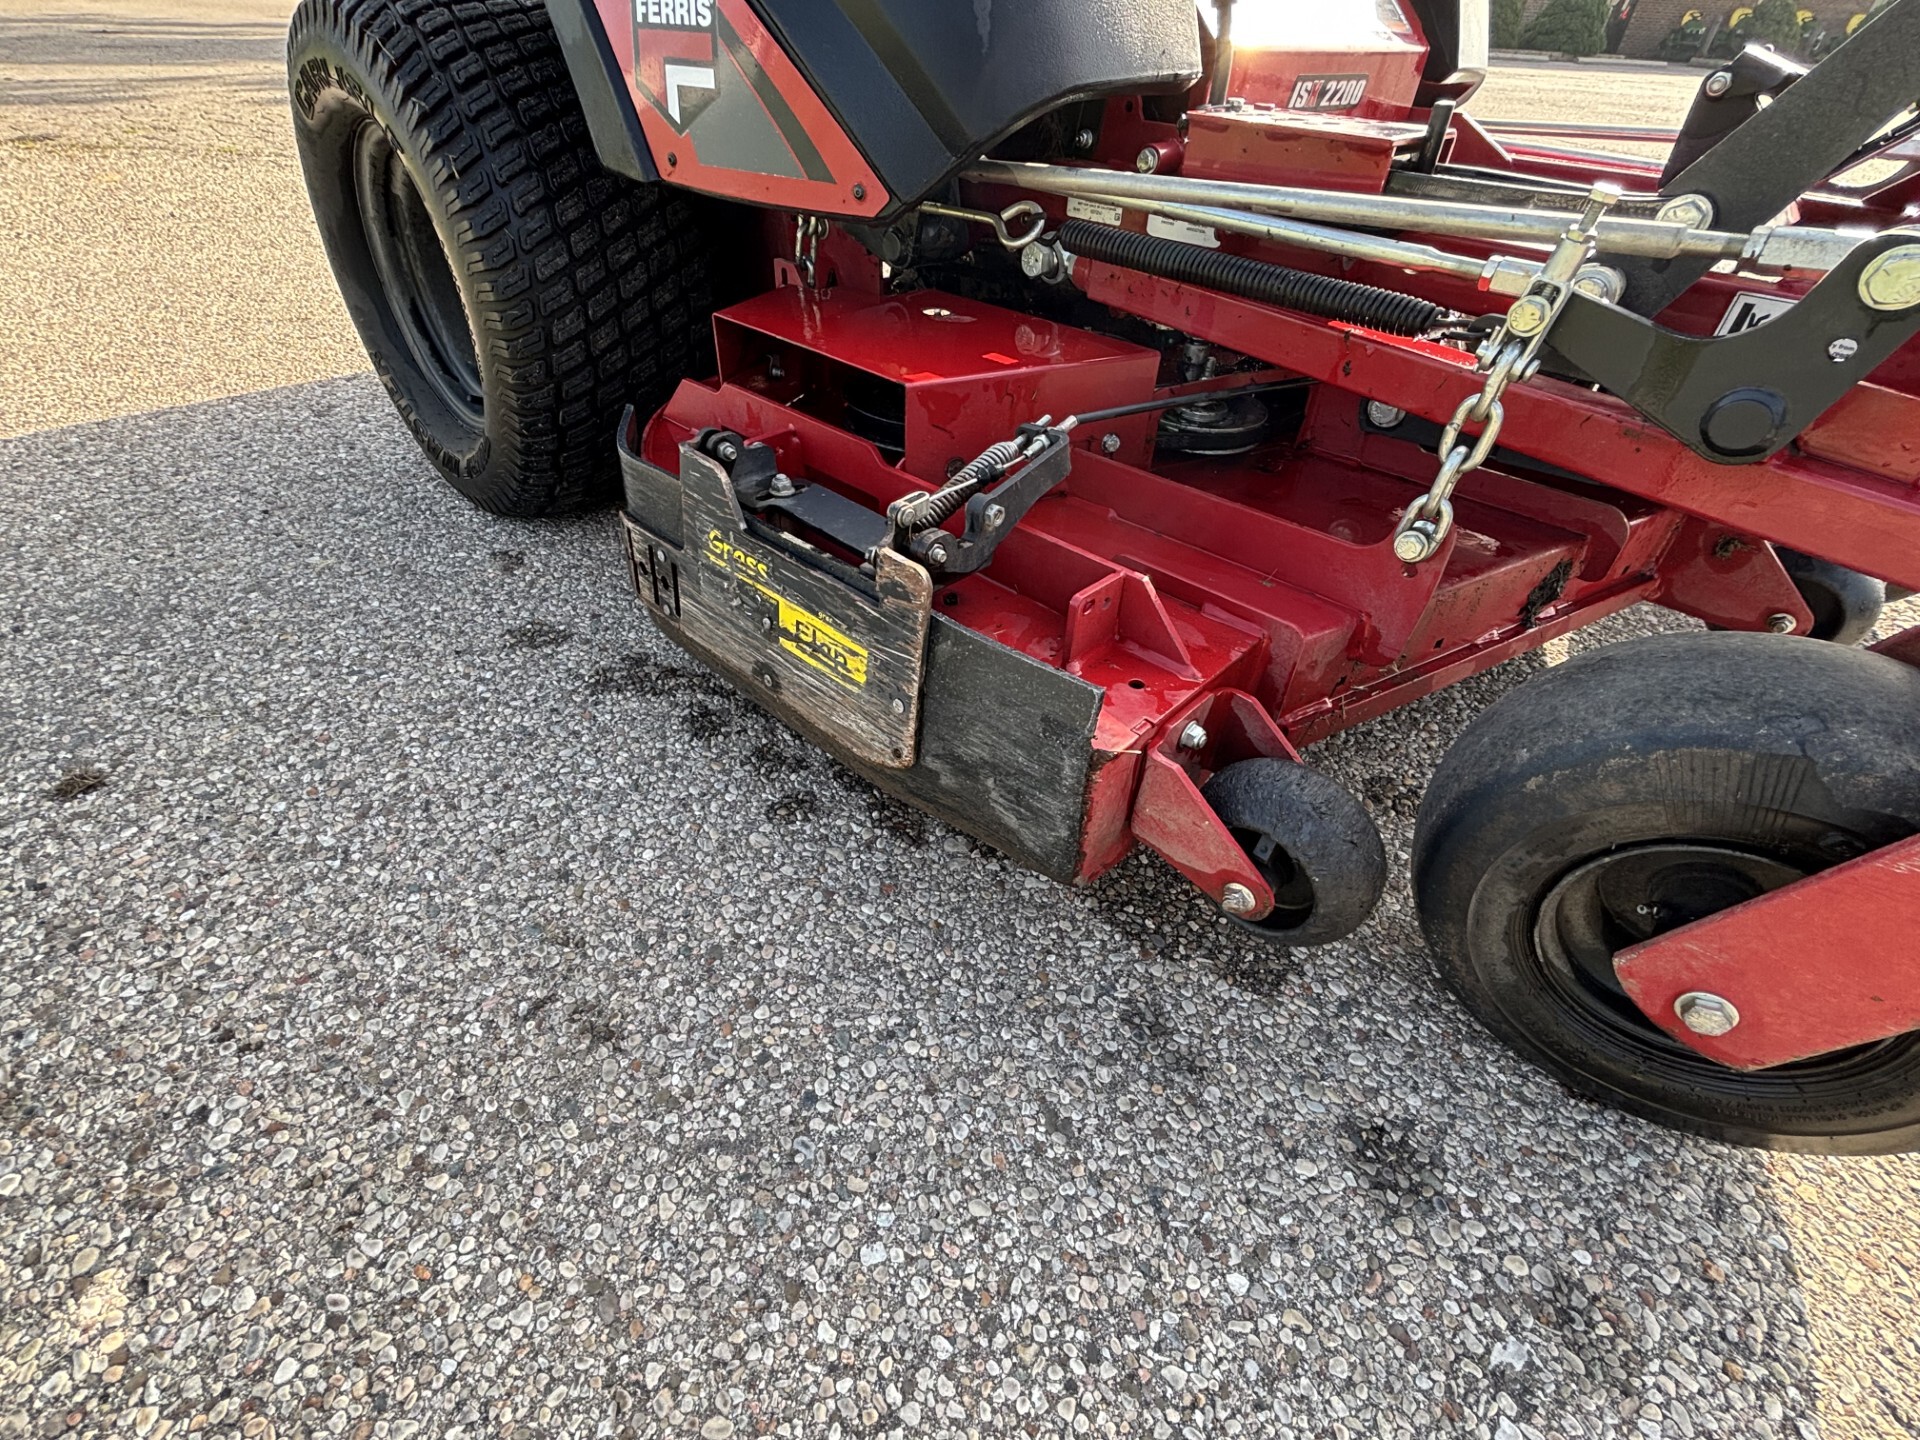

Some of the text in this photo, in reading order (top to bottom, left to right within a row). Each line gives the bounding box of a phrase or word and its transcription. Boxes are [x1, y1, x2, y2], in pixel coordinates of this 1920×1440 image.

[636, 0, 712, 27] FERRIS
[1287, 80, 1367, 108] ISX 2200
